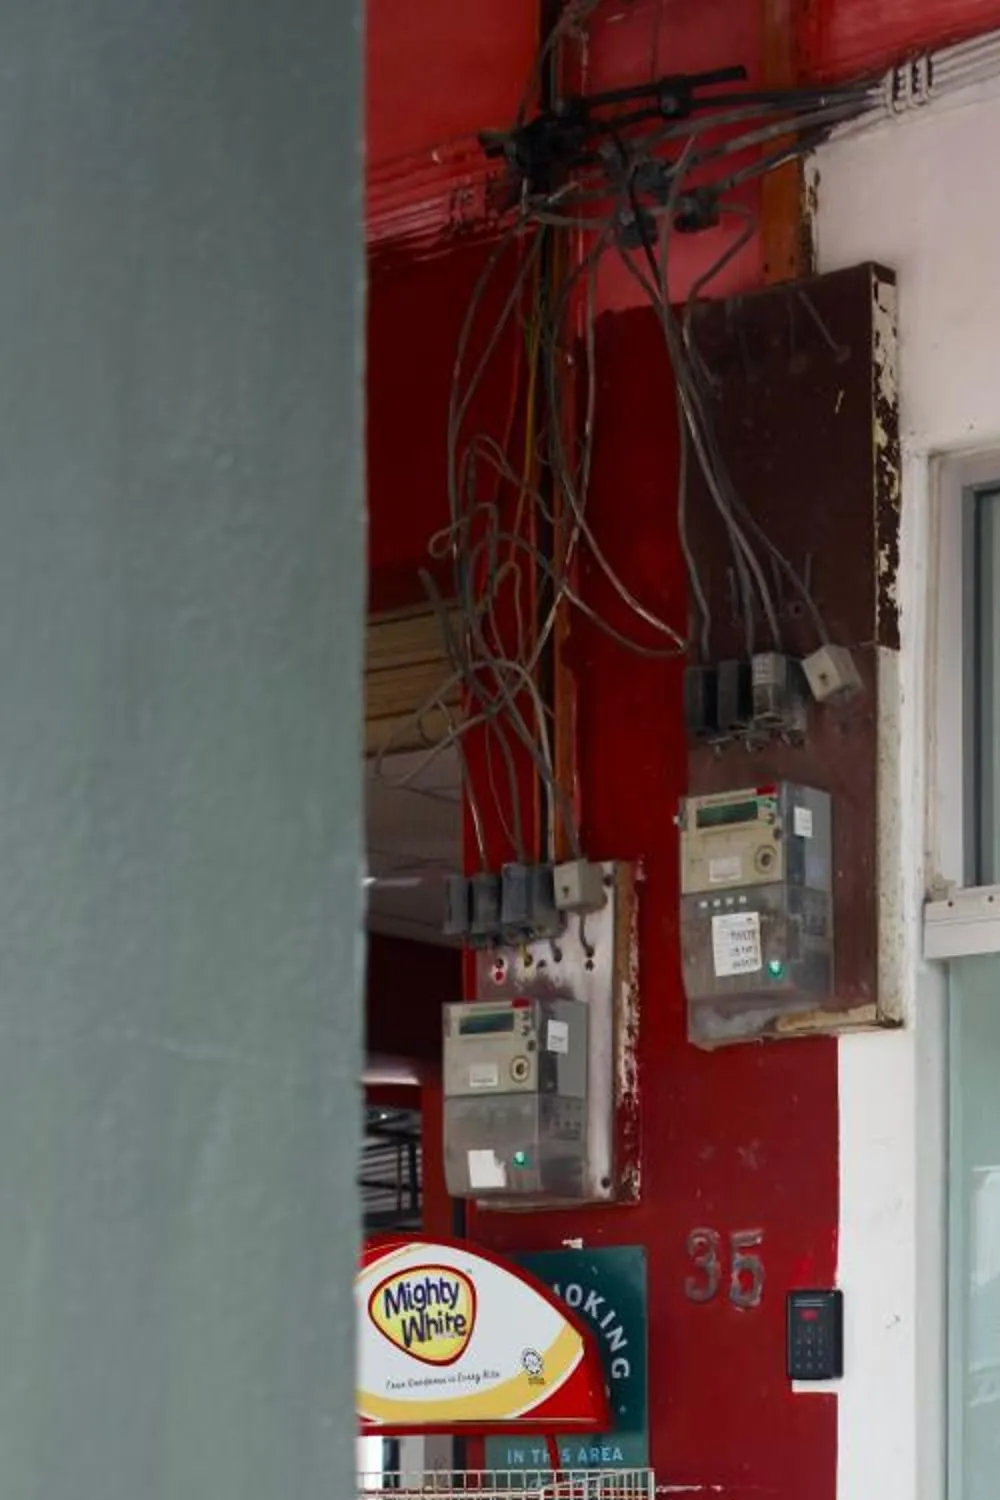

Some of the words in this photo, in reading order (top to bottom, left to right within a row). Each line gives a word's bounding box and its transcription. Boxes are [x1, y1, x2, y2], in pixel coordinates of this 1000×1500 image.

[684, 1227, 766, 1312] 35
[384, 1276, 459, 1319] Mighty
[401, 1310, 467, 1348] White
[554, 1283, 631, 1379] OKING
[507, 1447, 524, 1465] IN
[532, 1446, 571, 1463] THS
[577, 1445, 623, 1463] AREA
